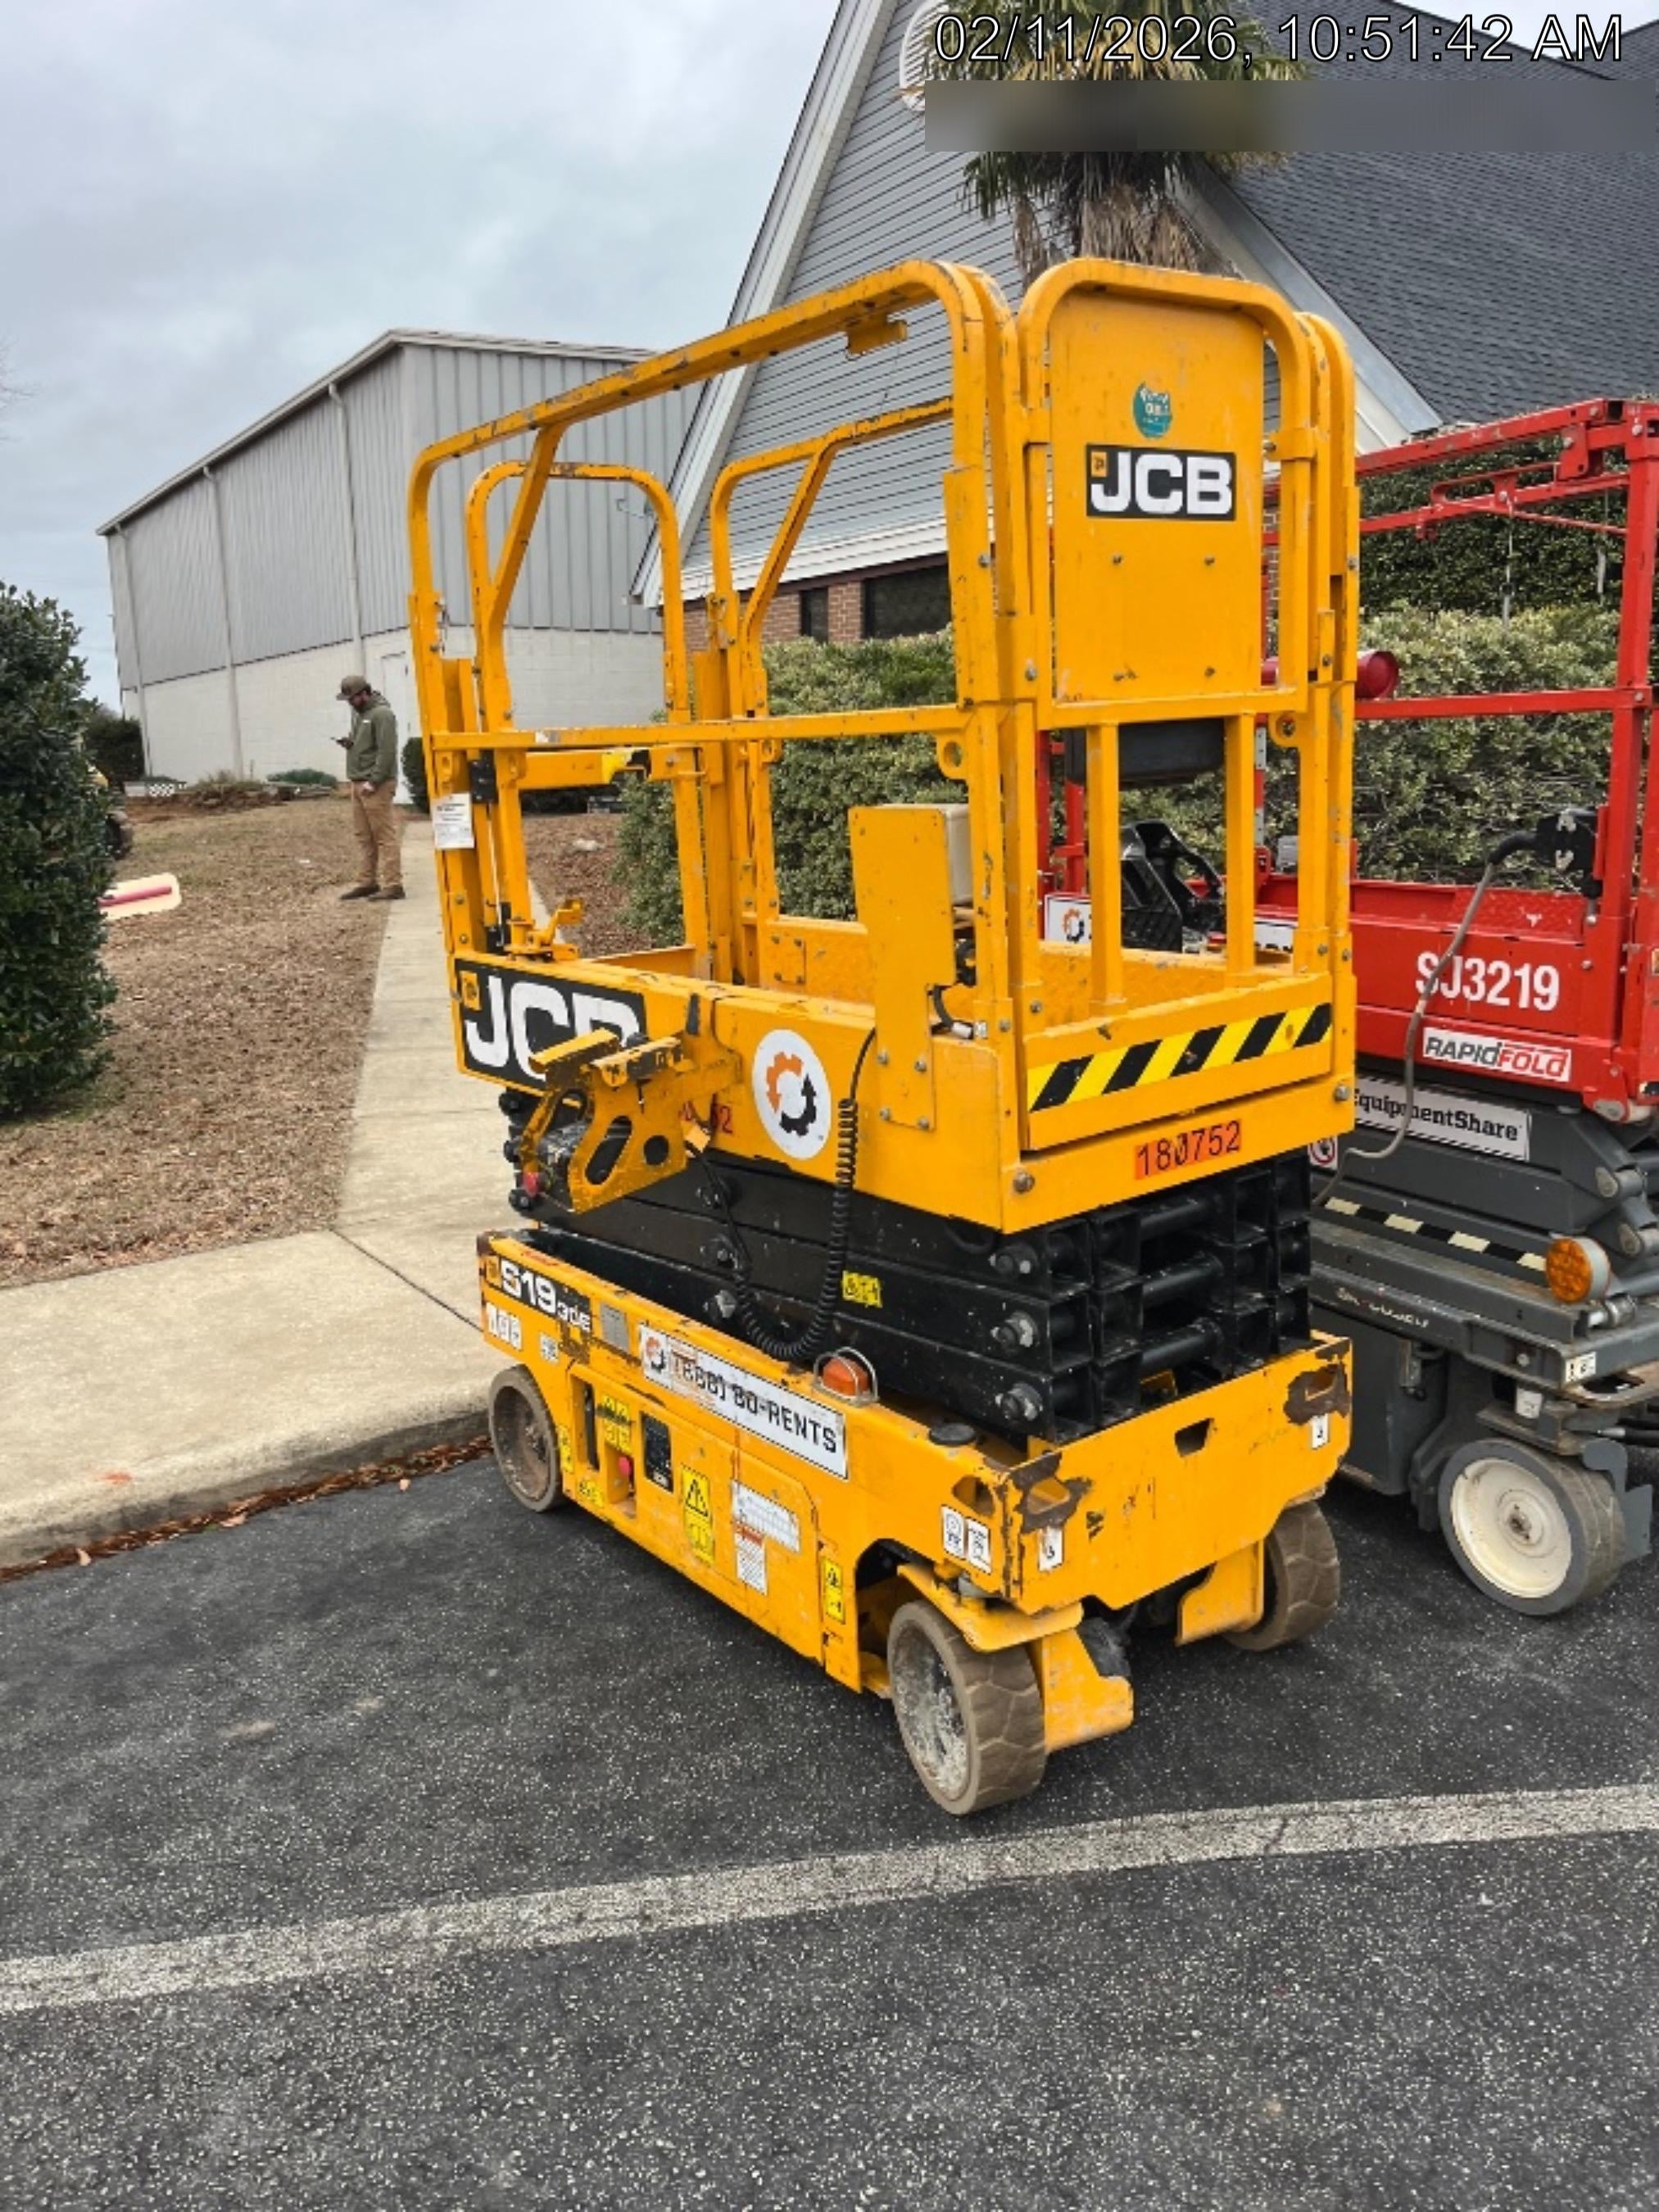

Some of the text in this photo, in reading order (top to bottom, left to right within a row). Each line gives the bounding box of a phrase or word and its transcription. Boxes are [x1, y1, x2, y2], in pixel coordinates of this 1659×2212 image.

[1090, 451, 1233, 515] JCB
[1415, 952, 1561, 1012] SJ3219
[1354, 1088, 1518, 1141] quipmentShare
[1138, 1120, 1240, 1176] 180752
